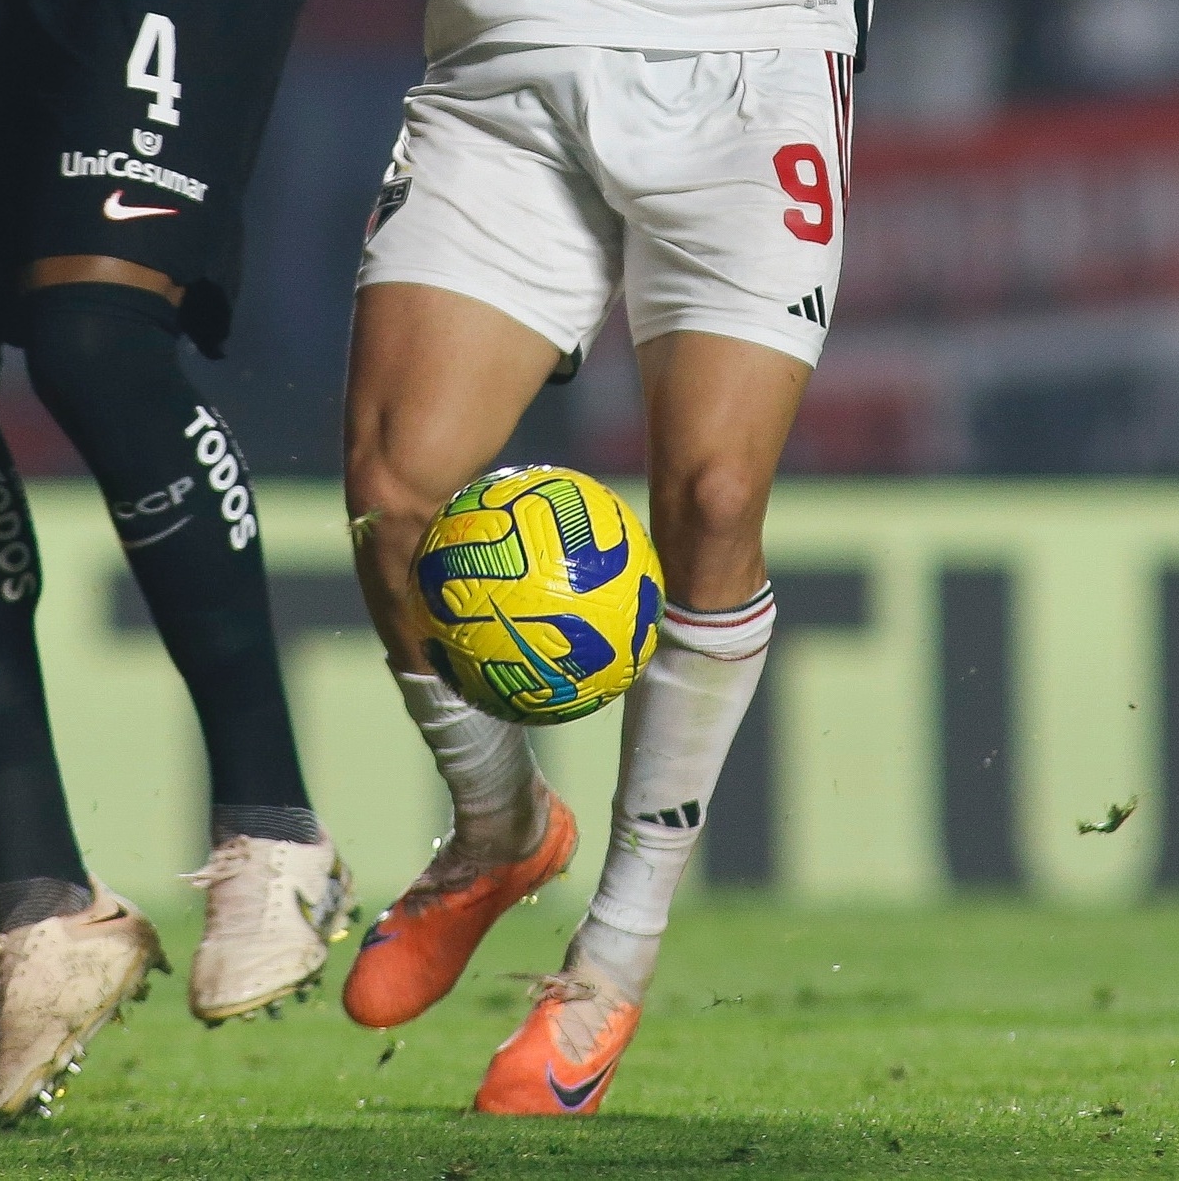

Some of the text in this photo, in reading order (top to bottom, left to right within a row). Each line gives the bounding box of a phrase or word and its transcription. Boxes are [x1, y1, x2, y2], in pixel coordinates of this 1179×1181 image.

[126, 12, 182, 127] 4
[60, 148, 210, 203] UniCesumar
[772, 142, 834, 245] 9
[183, 404, 258, 552] TODOS
